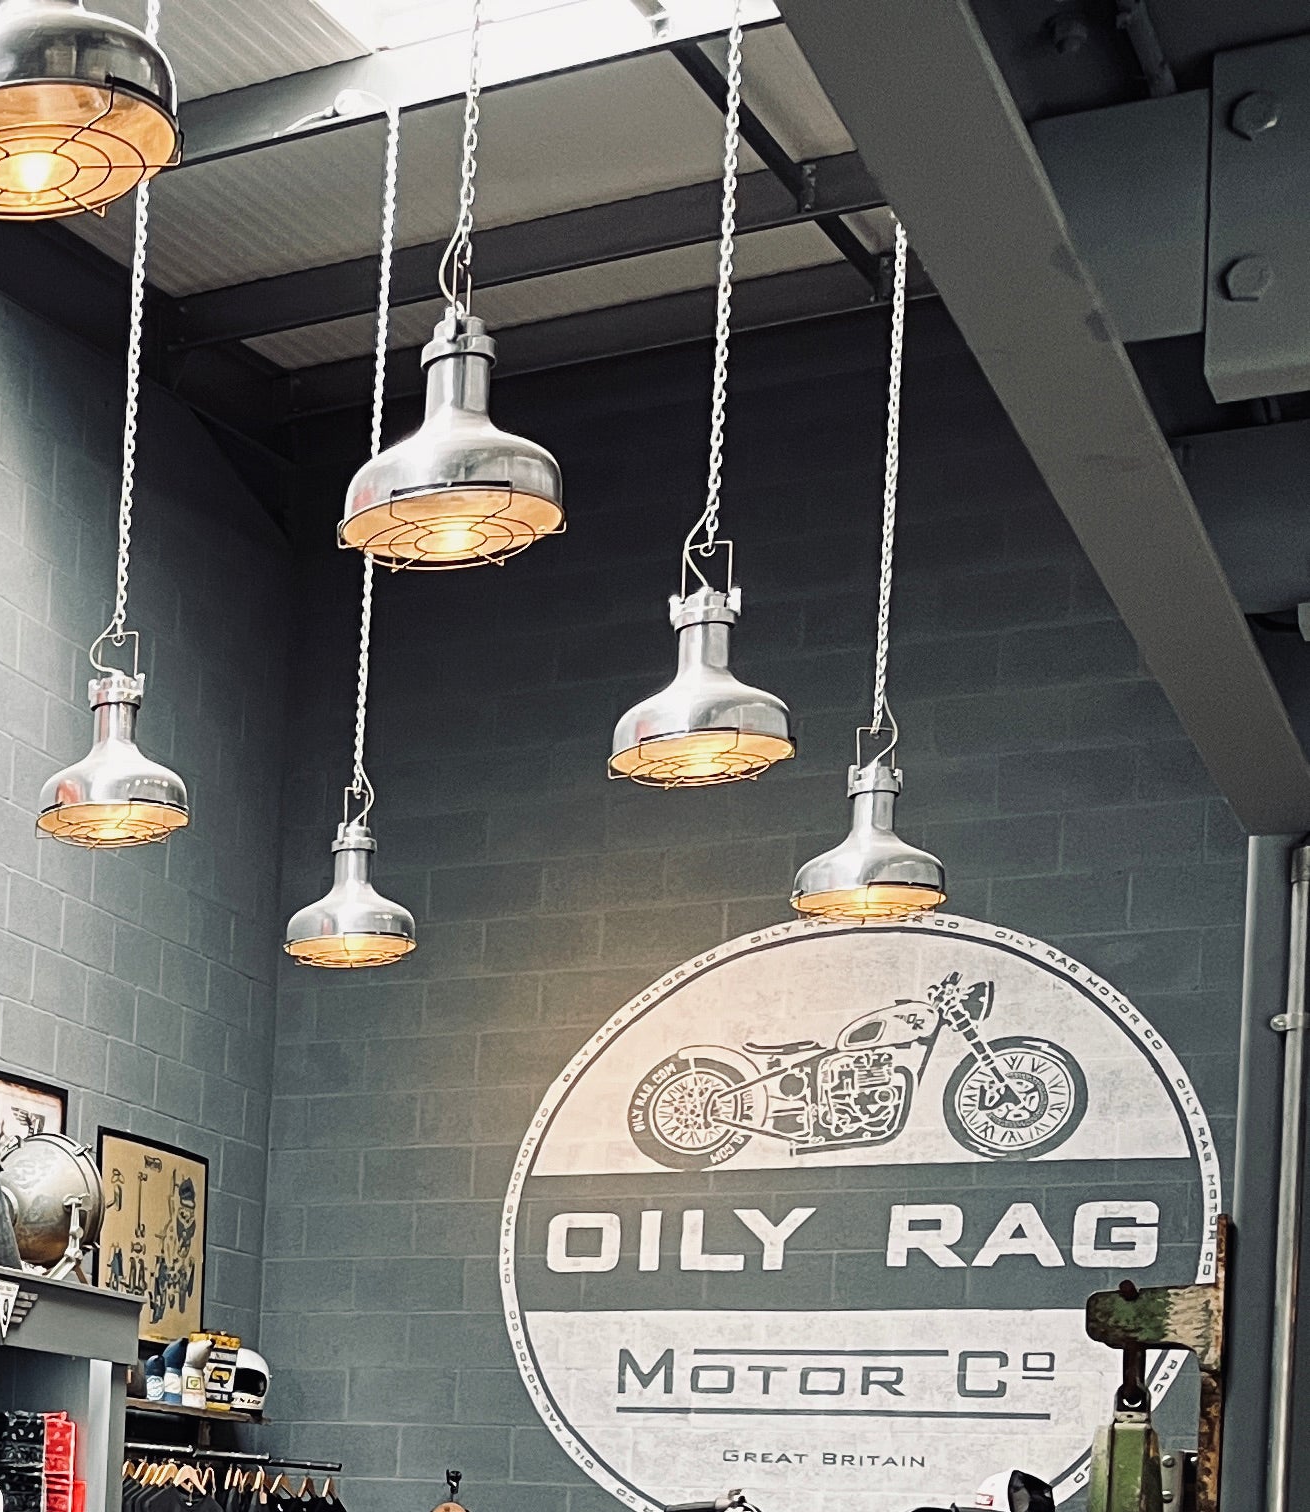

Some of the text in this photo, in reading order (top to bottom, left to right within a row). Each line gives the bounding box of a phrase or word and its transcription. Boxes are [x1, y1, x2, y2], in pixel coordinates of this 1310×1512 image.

[750, 925, 792, 944] OILY
[934, 918, 960, 929] CO
[994, 930, 1163, 1051] OILY RAG MOTOR CO
[562, 952, 717, 1084] OILY RAG MOTOR CO
[632, 1108, 646, 1133] OILY
[503, 1106, 549, 1284] OILY RAG MOTOR CO
[1175, 1078, 1218, 1277] OILY RAG MOTOR CO
[545, 1201, 1160, 1273] OILY RAG
[515, 1339, 540, 1395] MOTOR
[1154, 1359, 1178, 1393] RAG
[541, 1400, 563, 1433] RAG
[564, 1437, 595, 1470] OILY
